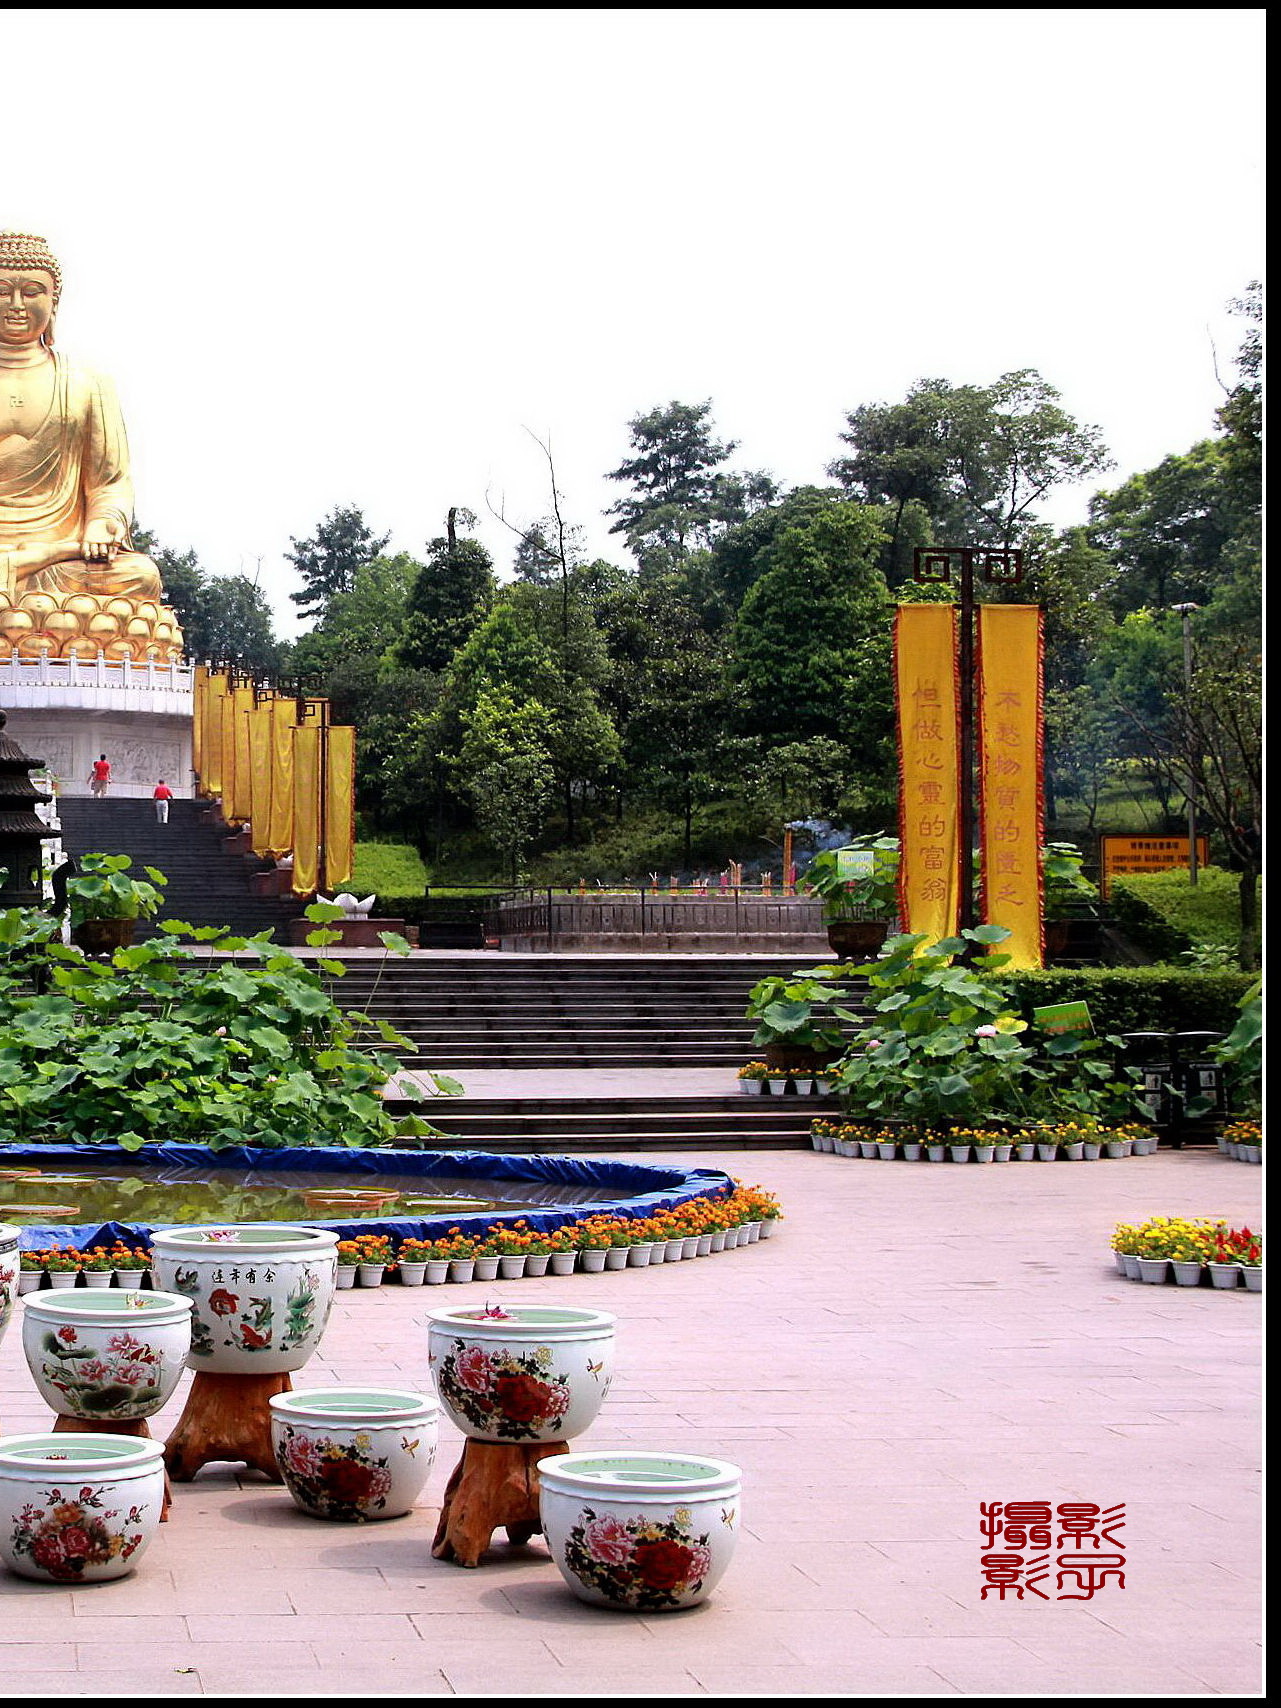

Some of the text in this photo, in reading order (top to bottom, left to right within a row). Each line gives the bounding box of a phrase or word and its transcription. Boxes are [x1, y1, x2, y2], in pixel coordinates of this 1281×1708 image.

[912, 680, 948, 903] 但做心靈的富翁
[994, 691, 1024, 906] 不愁物質的匱乏
